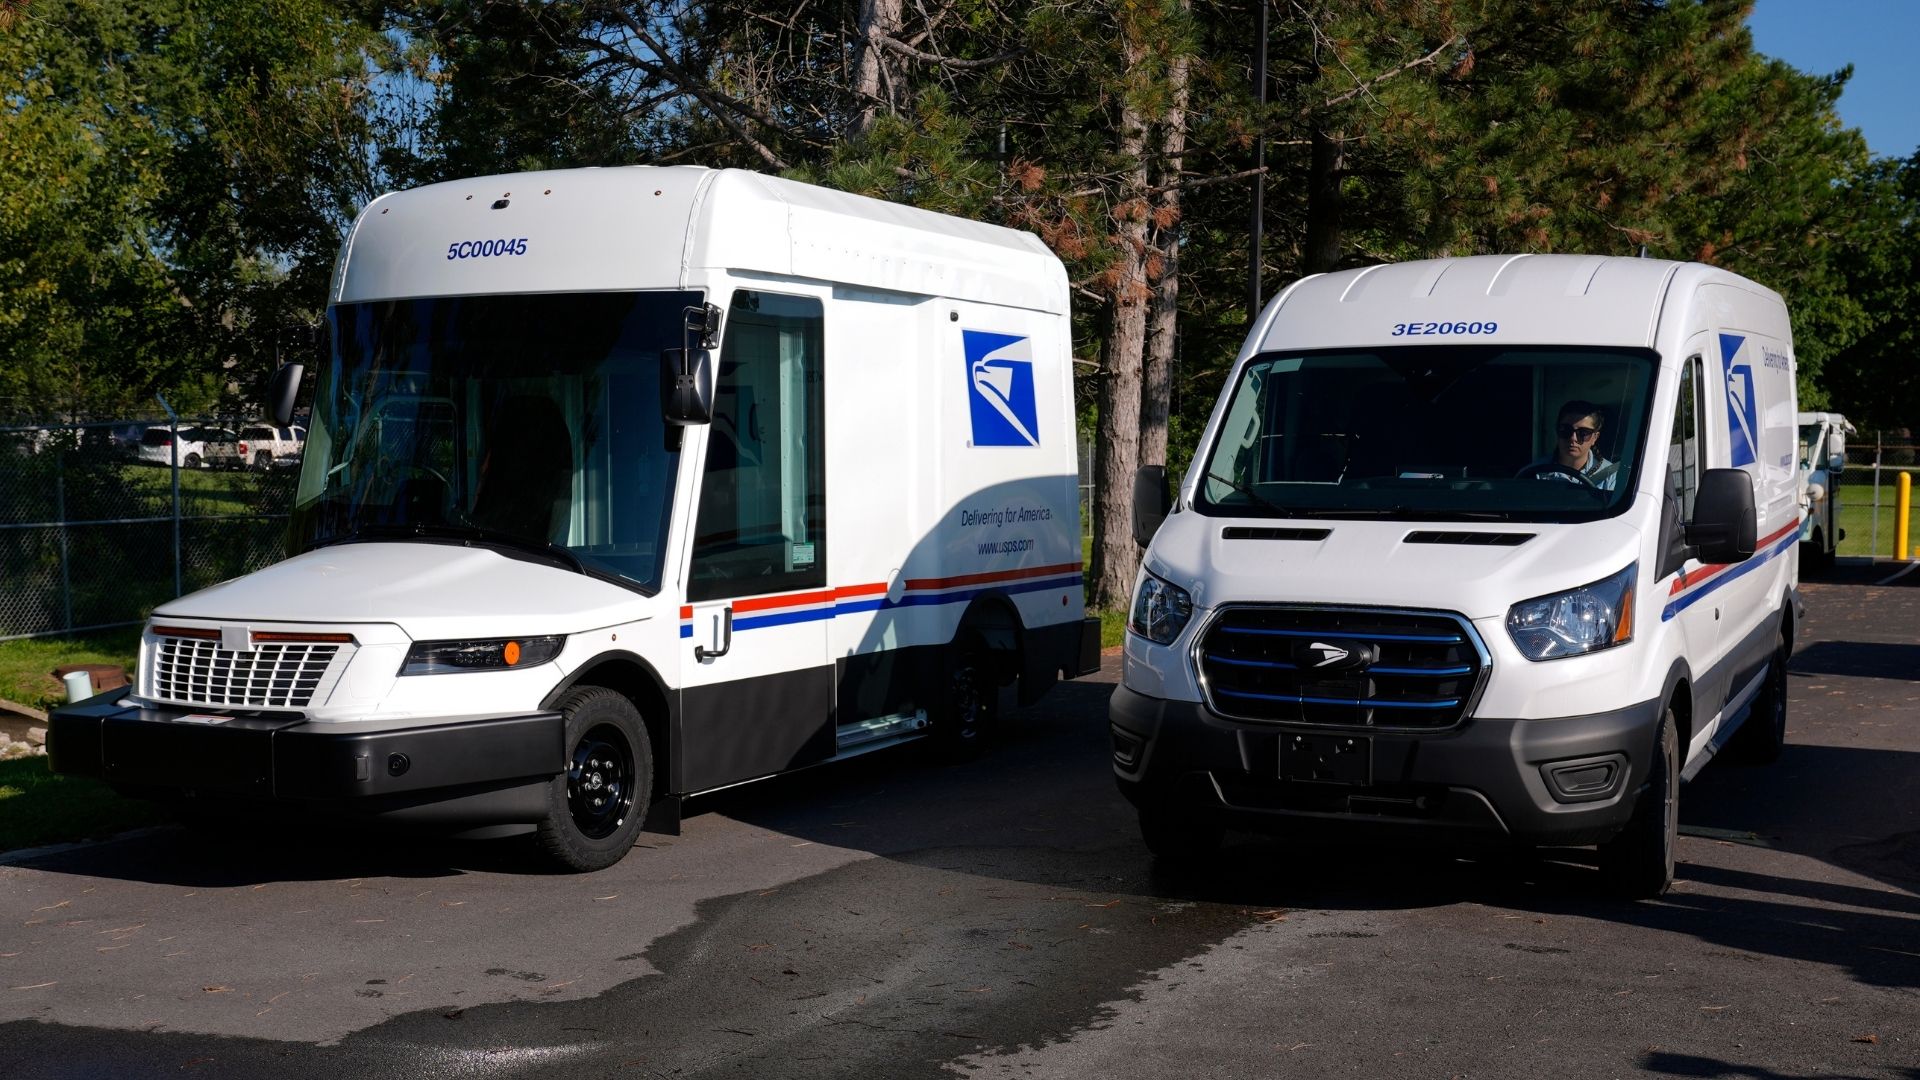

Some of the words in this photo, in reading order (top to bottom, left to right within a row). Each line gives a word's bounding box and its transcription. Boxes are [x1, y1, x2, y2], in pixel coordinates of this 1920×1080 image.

[447, 238, 528, 260] 5C00045
[1391, 321, 1498, 336] 3E20609
[961, 508, 1004, 528] Delivering
[1005, 506, 1018, 523] for
[978, 538, 1035, 556] www.usps.com
